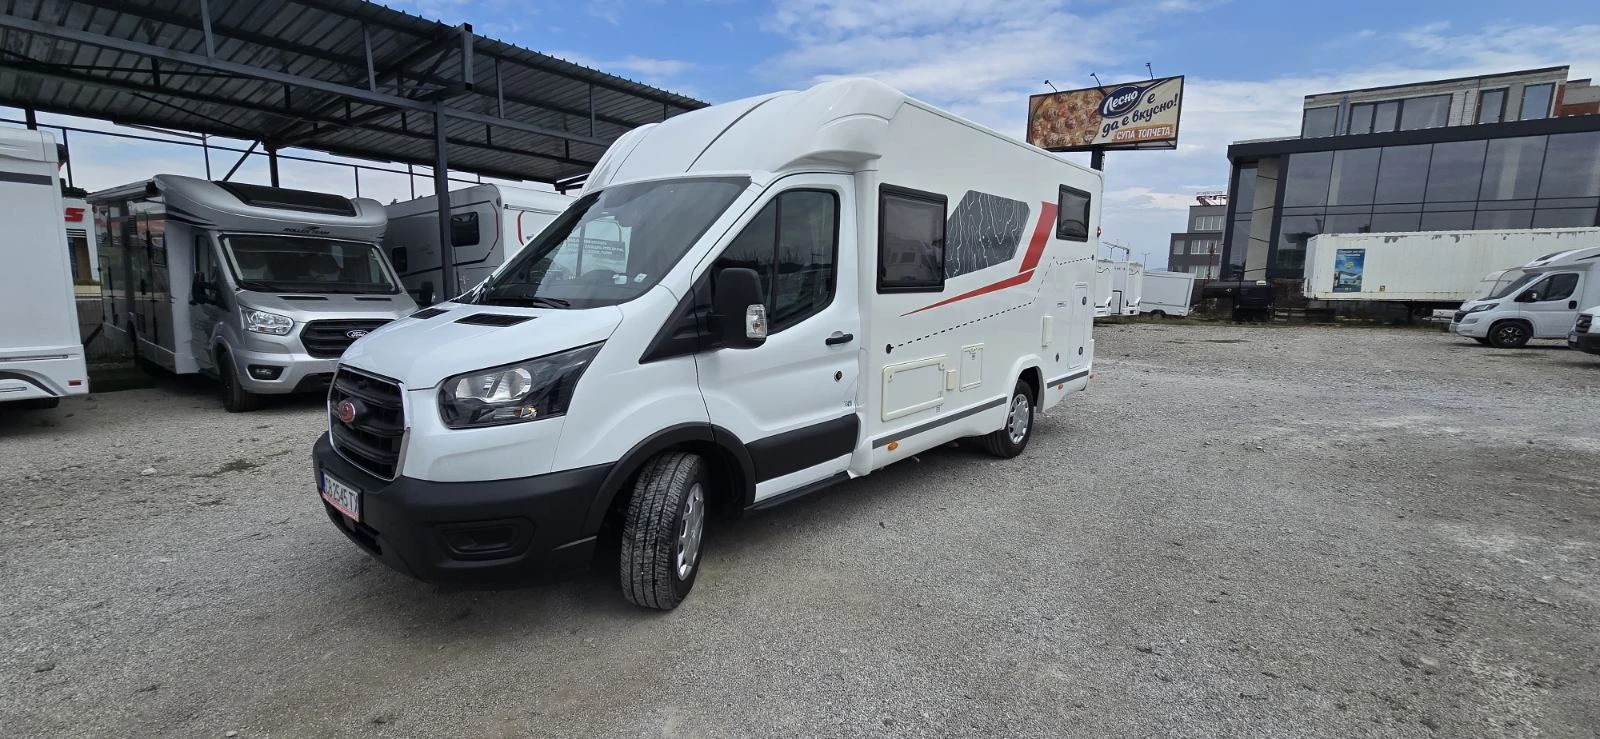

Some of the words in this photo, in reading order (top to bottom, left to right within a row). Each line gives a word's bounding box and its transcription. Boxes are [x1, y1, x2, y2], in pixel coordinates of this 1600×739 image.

[1103, 90, 1138, 114] Лесно
[1147, 93, 1156, 104] е
[1102, 119, 1119, 138] да
[1122, 116, 1130, 126] е
[1132, 93, 1178, 123] вкусно!
[1116, 129, 1136, 140] СУПА
[1138, 126, 1171, 138] ТОПЧЕТА
